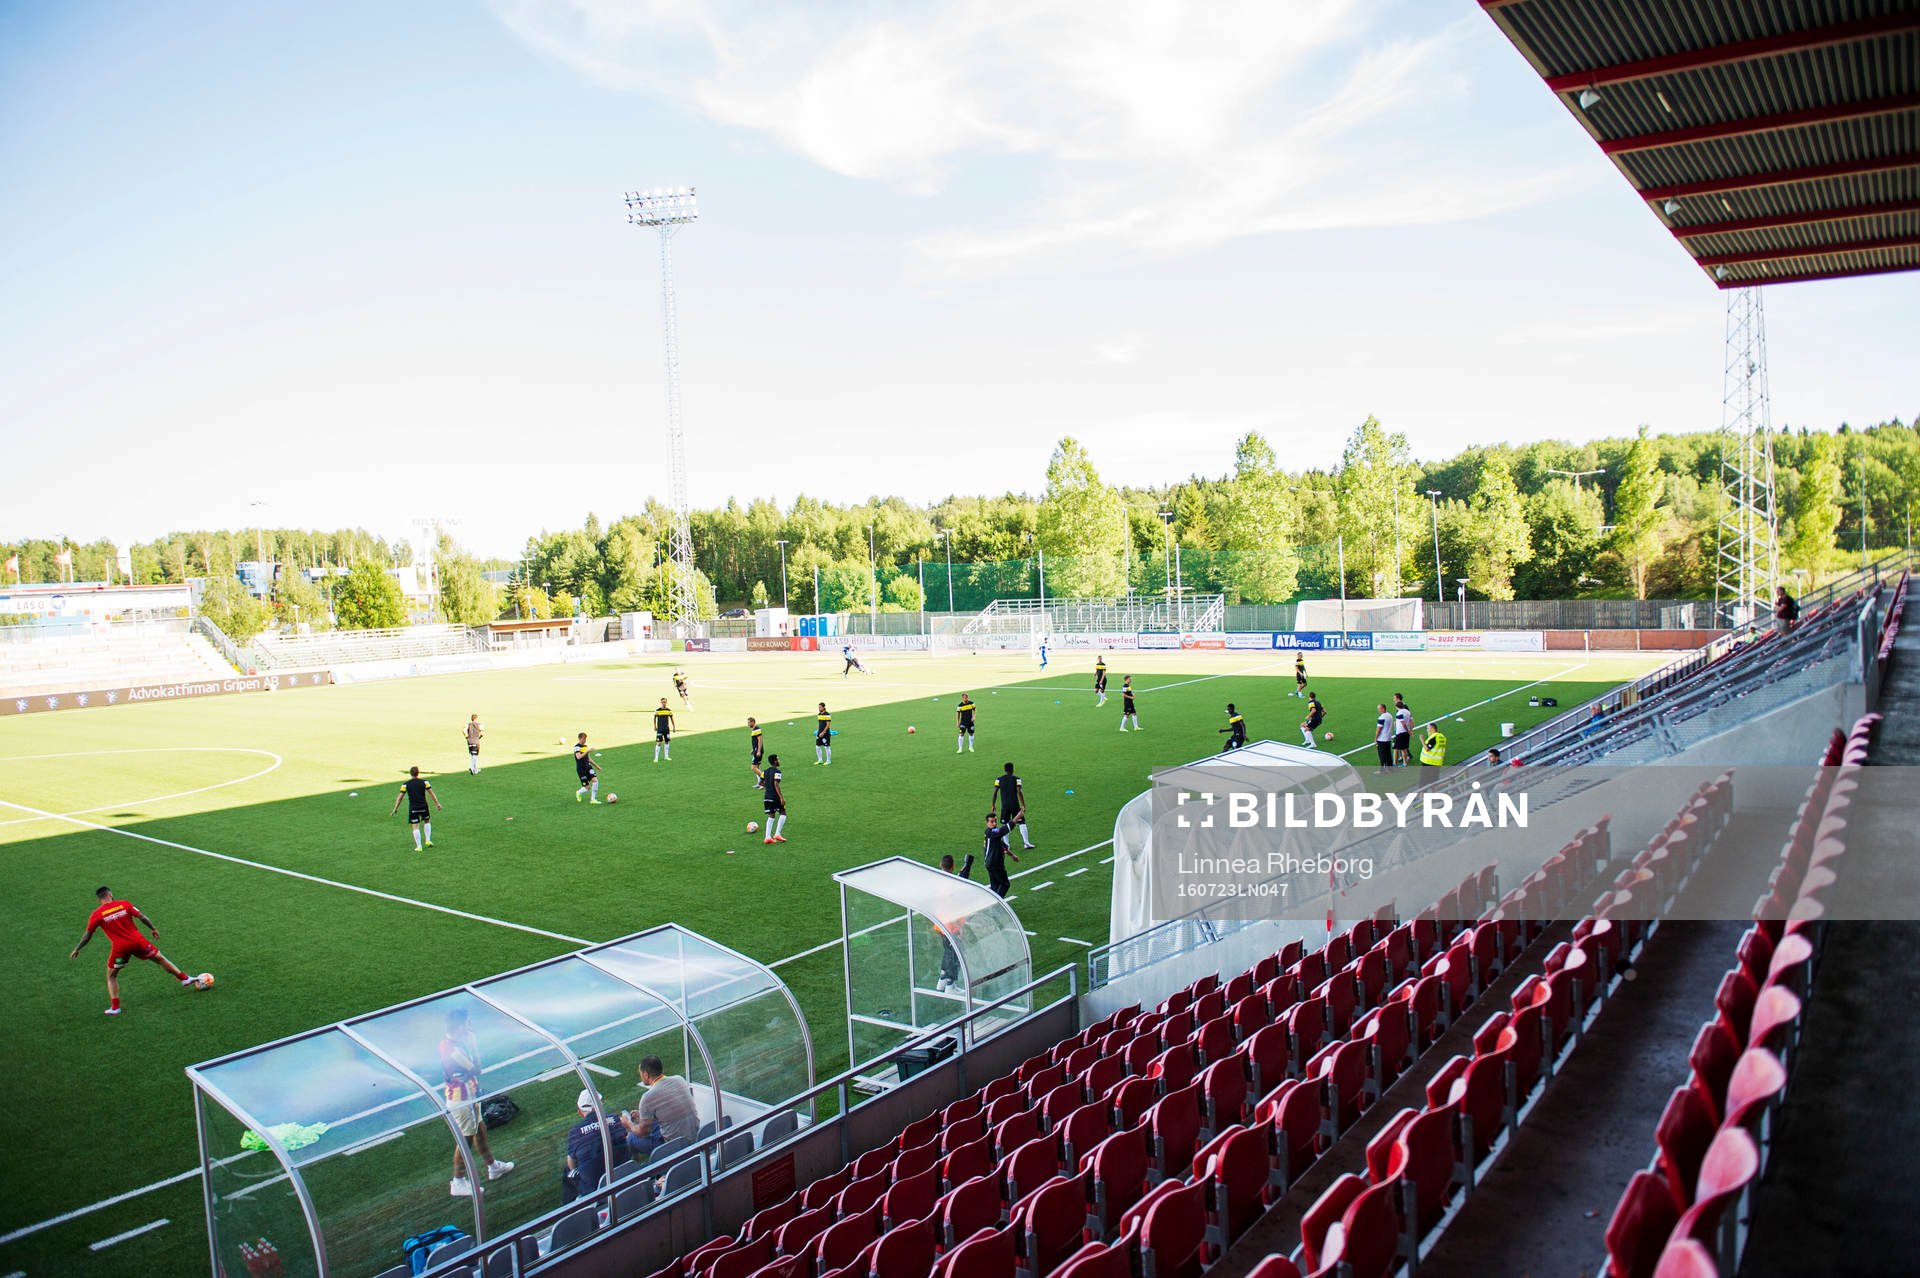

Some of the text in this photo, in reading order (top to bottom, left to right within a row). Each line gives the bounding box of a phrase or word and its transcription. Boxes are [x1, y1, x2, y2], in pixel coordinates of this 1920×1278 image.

[1098, 635, 1137, 645] itsperfect
[1276, 635, 1298, 648] ATA
[128, 676, 279, 701] Advokatfirman Gripen AB
